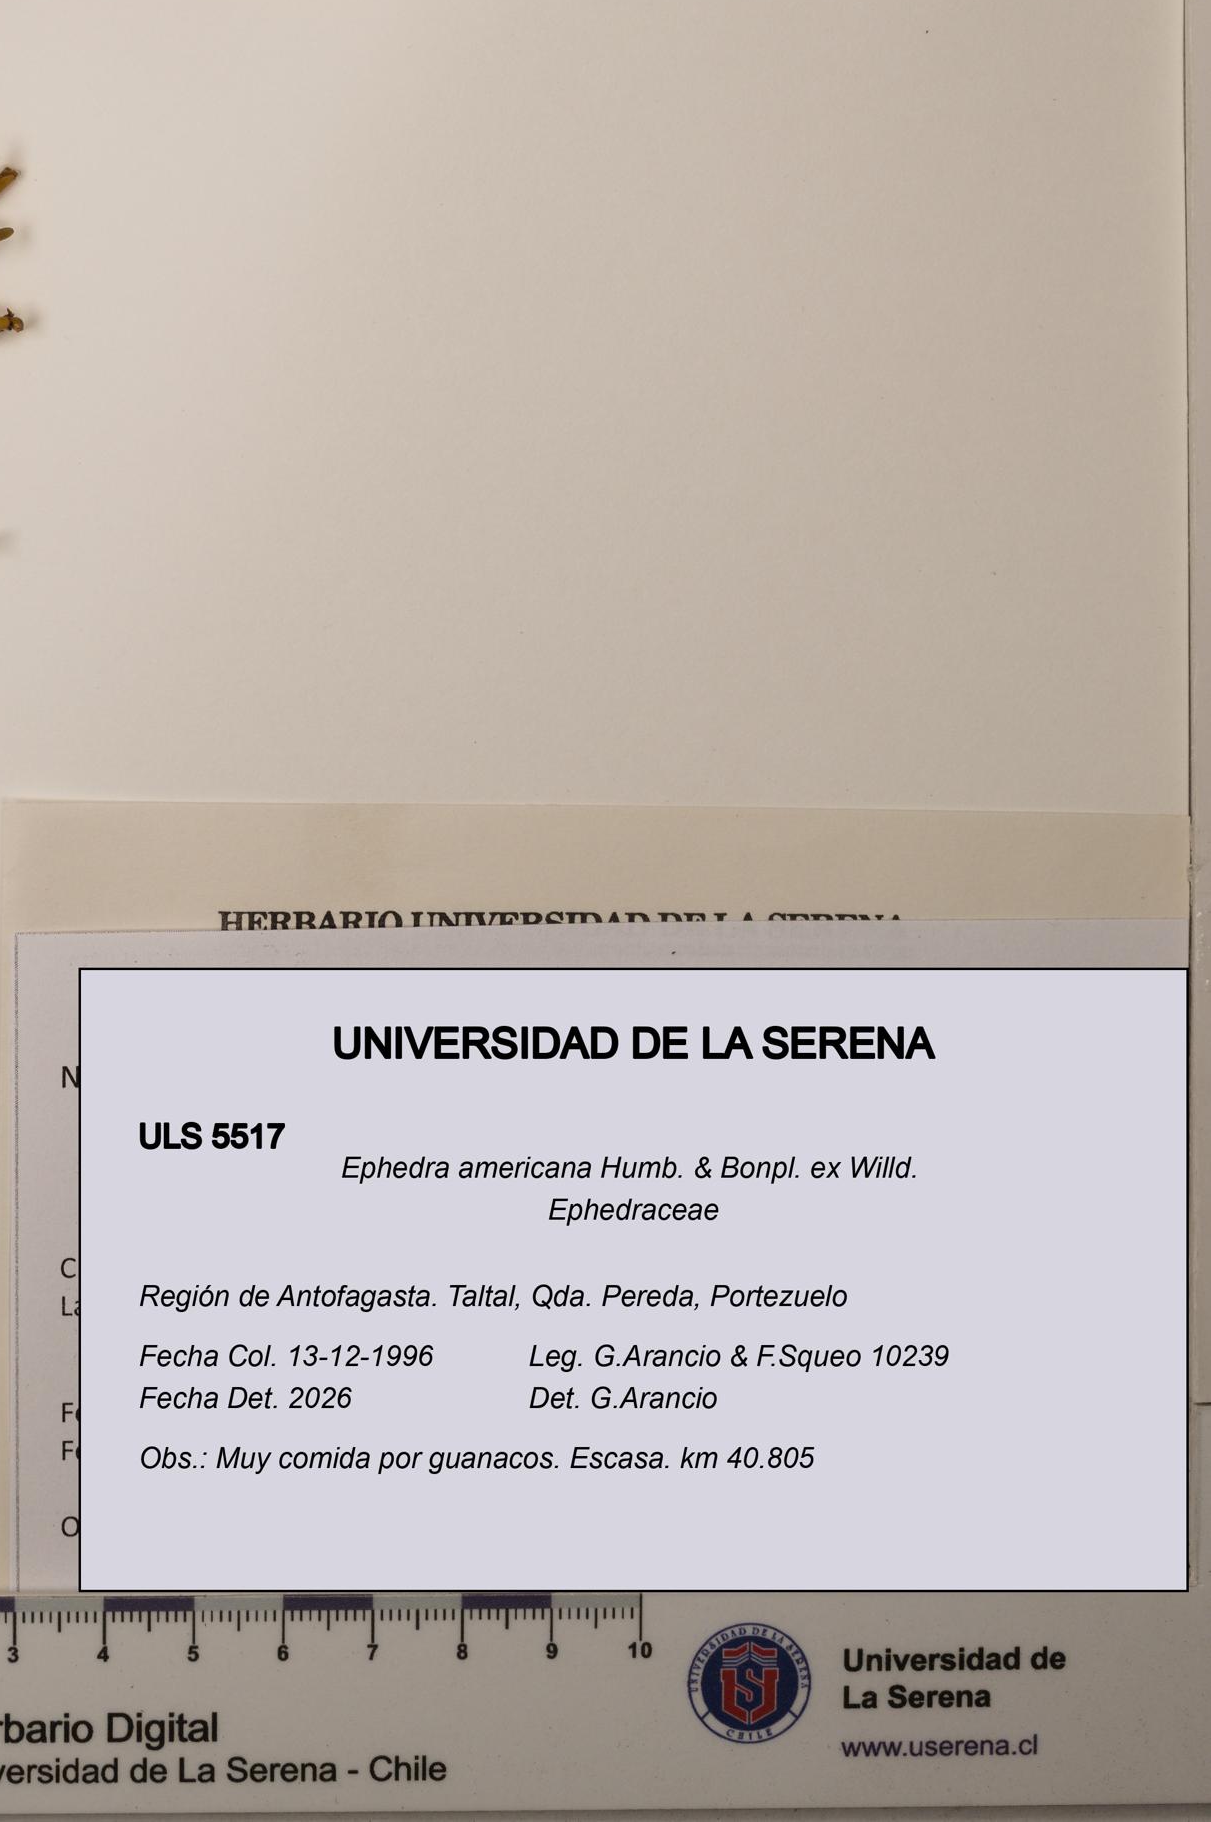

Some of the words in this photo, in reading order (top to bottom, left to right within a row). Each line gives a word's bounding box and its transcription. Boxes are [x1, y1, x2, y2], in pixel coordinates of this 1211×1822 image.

[217, 910, 404, 931] HERBARIO
[7, 1647, 20, 1664] 3
[96, 1646, 110, 1663] 4
[186, 1646, 200, 1663] 5
[276, 1645, 290, 1662] 6
[366, 1645, 379, 1662] 7
[456, 1644, 469, 1661] 8
[545, 1643, 559, 1660] 9
[627, 1642, 654, 1660] 10
[843, 1645, 1021, 1673] Universidad
[1030, 1645, 1067, 1671] de
[842, 1685, 878, 1710] La
[887, 1683, 992, 1710] Serena
[106, 1711, 219, 1751] Digital
[841, 1733, 1039, 1759] www.userena.cl
[129, 1756, 168, 1784] de
[178, 1756, 216, 1784] La
[226, 1755, 338, 1784] Serena
[369, 1754, 448, 1783] Chile
